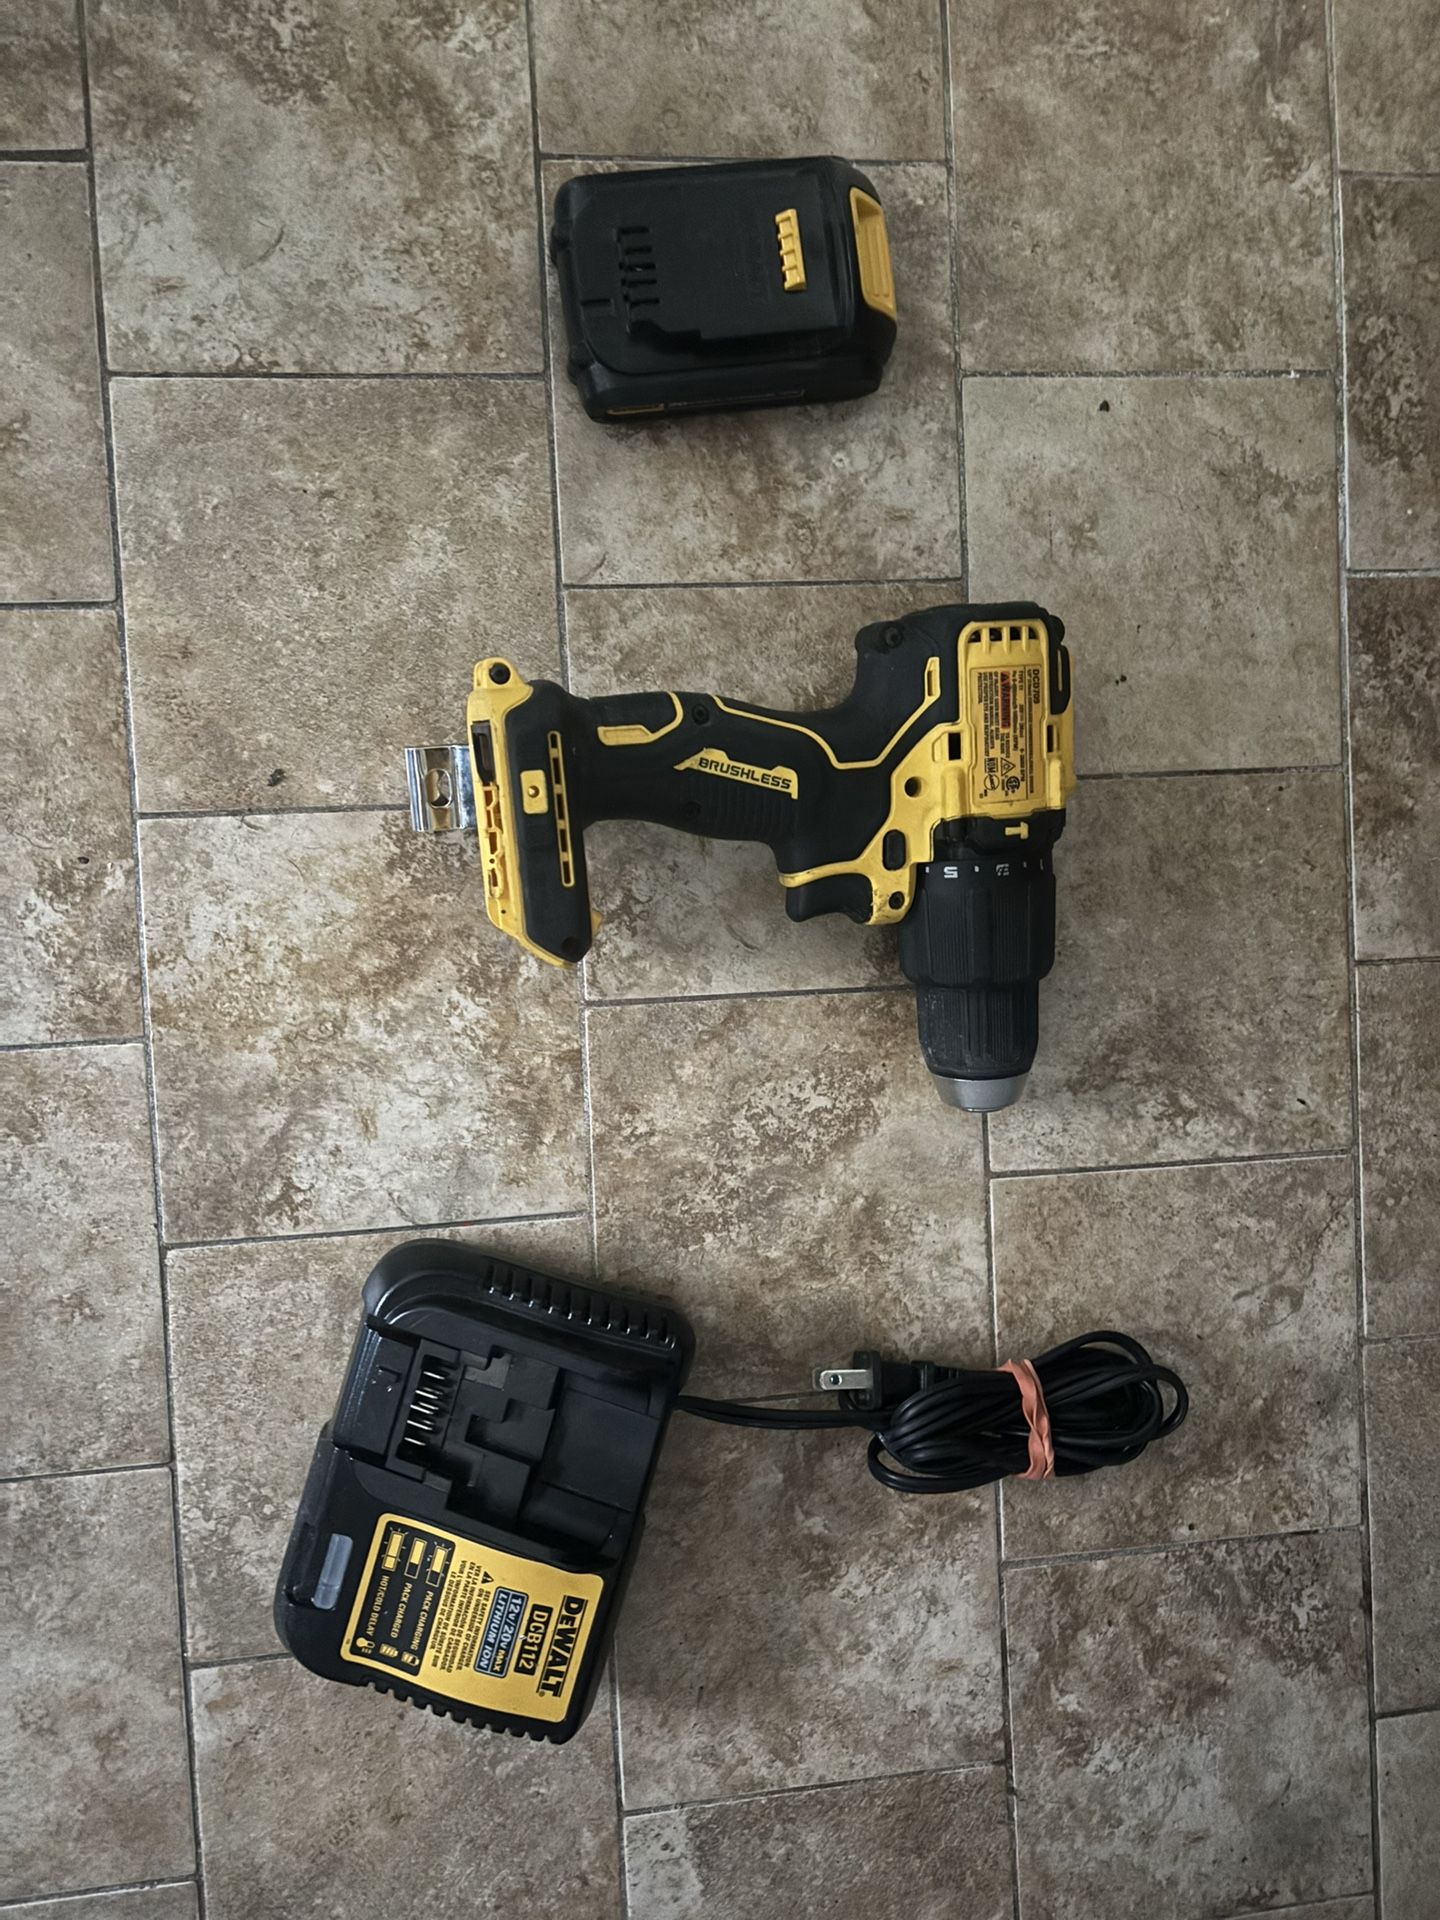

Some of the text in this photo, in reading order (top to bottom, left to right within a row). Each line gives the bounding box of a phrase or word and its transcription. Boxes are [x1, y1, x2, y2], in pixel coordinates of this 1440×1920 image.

[698, 757, 791, 789] BRUSHLESS
[365, 1574, 389, 1636] HOT/COLD DELAY
[390, 1582, 412, 1638] PACK CHARGED
[410, 1590, 433, 1650] PACK CHARGING
[478, 1592, 507, 1668] LITHIUM ION
[492, 1648, 505, 1671] MAX
[518, 1609, 548, 1671] DCB112
[539, 1595, 585, 1697] DEWALT
